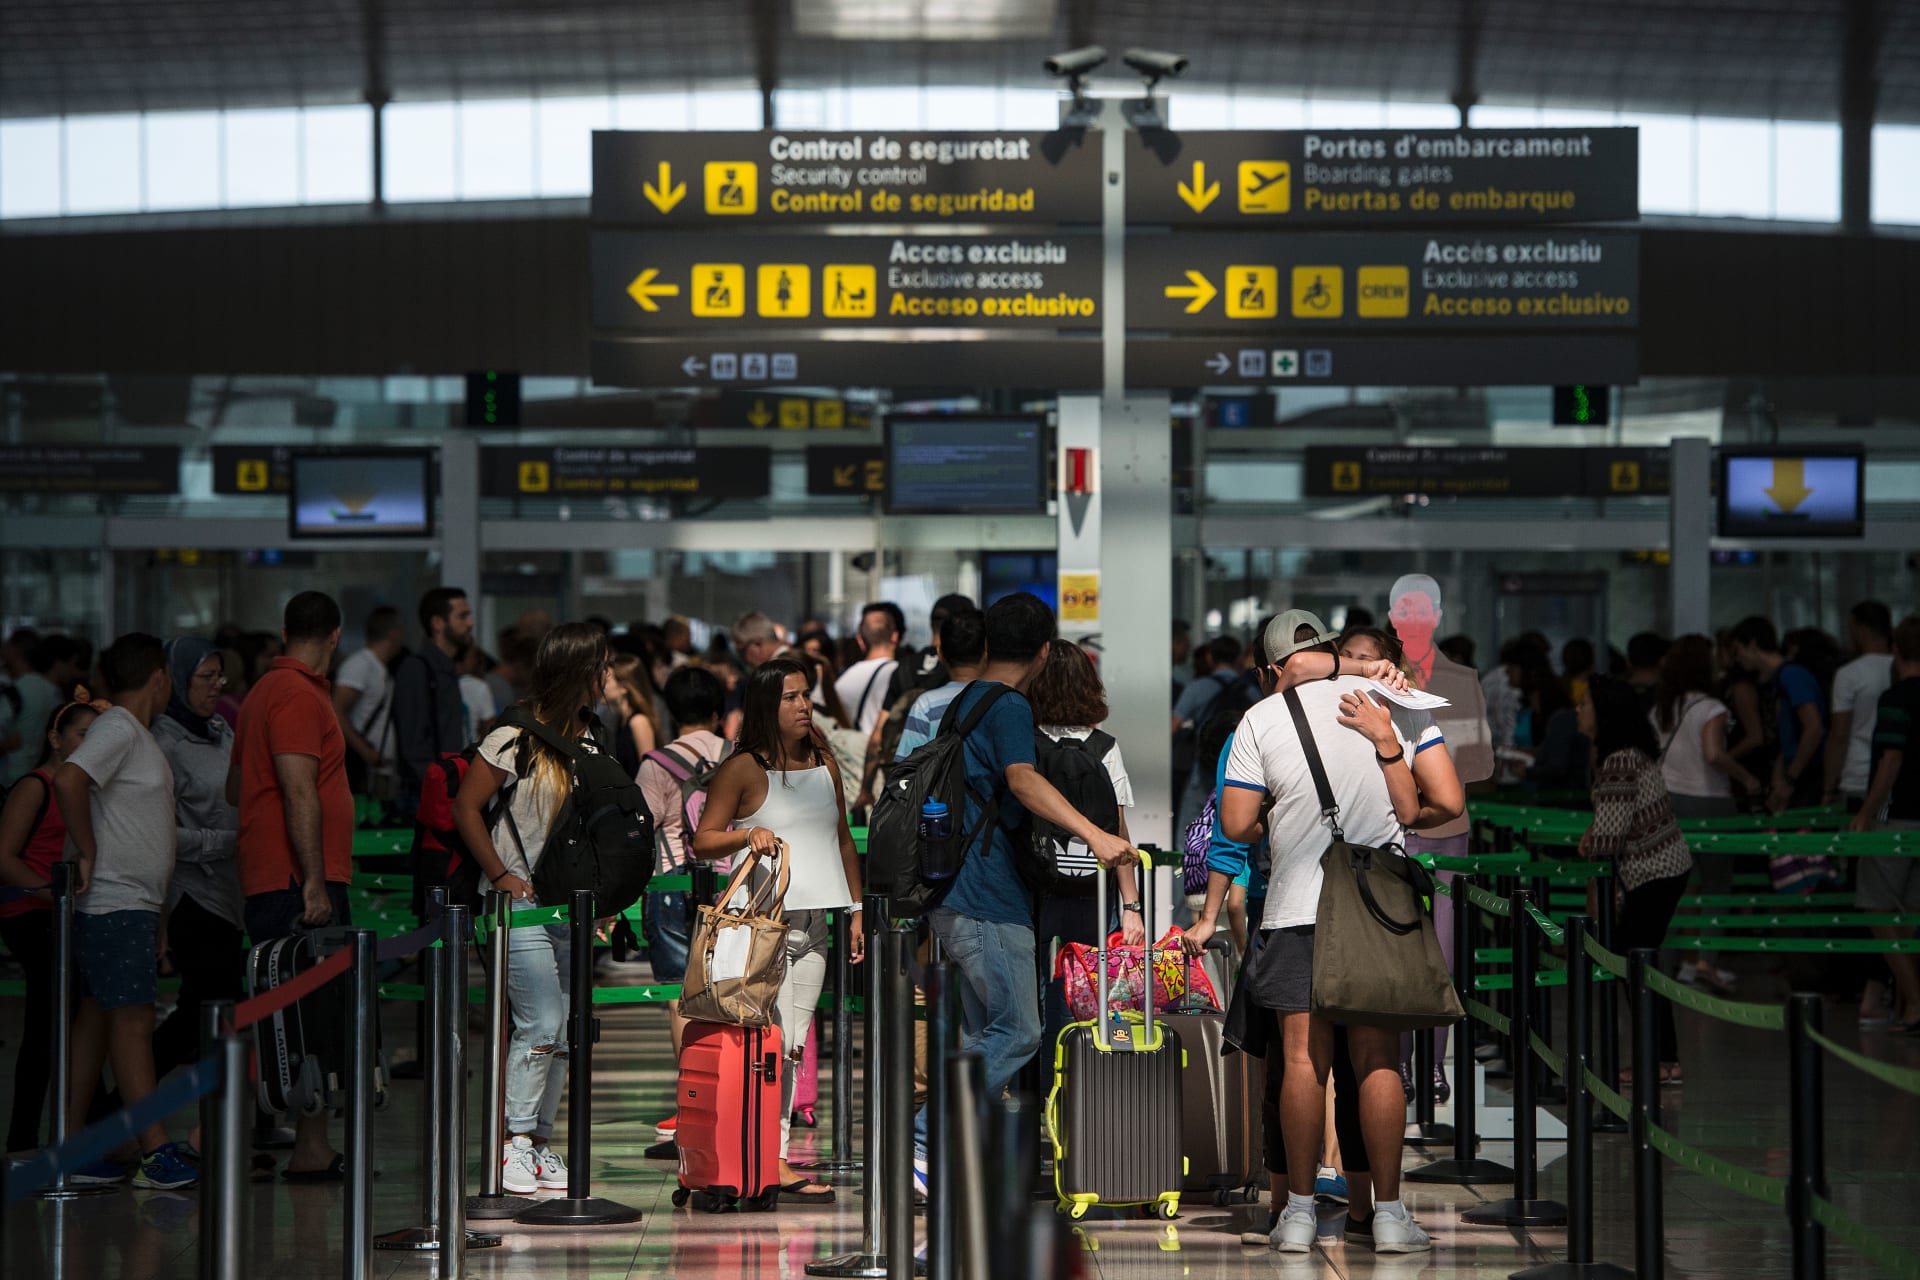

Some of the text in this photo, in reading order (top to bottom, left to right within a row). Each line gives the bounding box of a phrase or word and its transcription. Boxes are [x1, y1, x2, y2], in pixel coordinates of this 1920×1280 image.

[770, 135, 1030, 164] Control de seguretat
[1304, 134, 1592, 158] Portes d'embarcament
[771, 163, 927, 189] Security control
[1304, 162, 1453, 187] Boarding gates
[770, 188, 1034, 216] Control de seguridad
[1304, 186, 1576, 213] Puertas de embarque
[967, 240, 1066, 264] exclusiu
[1502, 240, 1601, 263] exclusiu
[888, 266, 1043, 289] Exclusive access
[1422, 268, 1579, 288] Exclusive access
[889, 291, 1095, 316] Acceso exclusivo
[1360, 284, 1406, 299] CREW
[1423, 292, 1630, 315] Acceso exclusivo
[277, 1028, 288, 1087] LAGUNA
